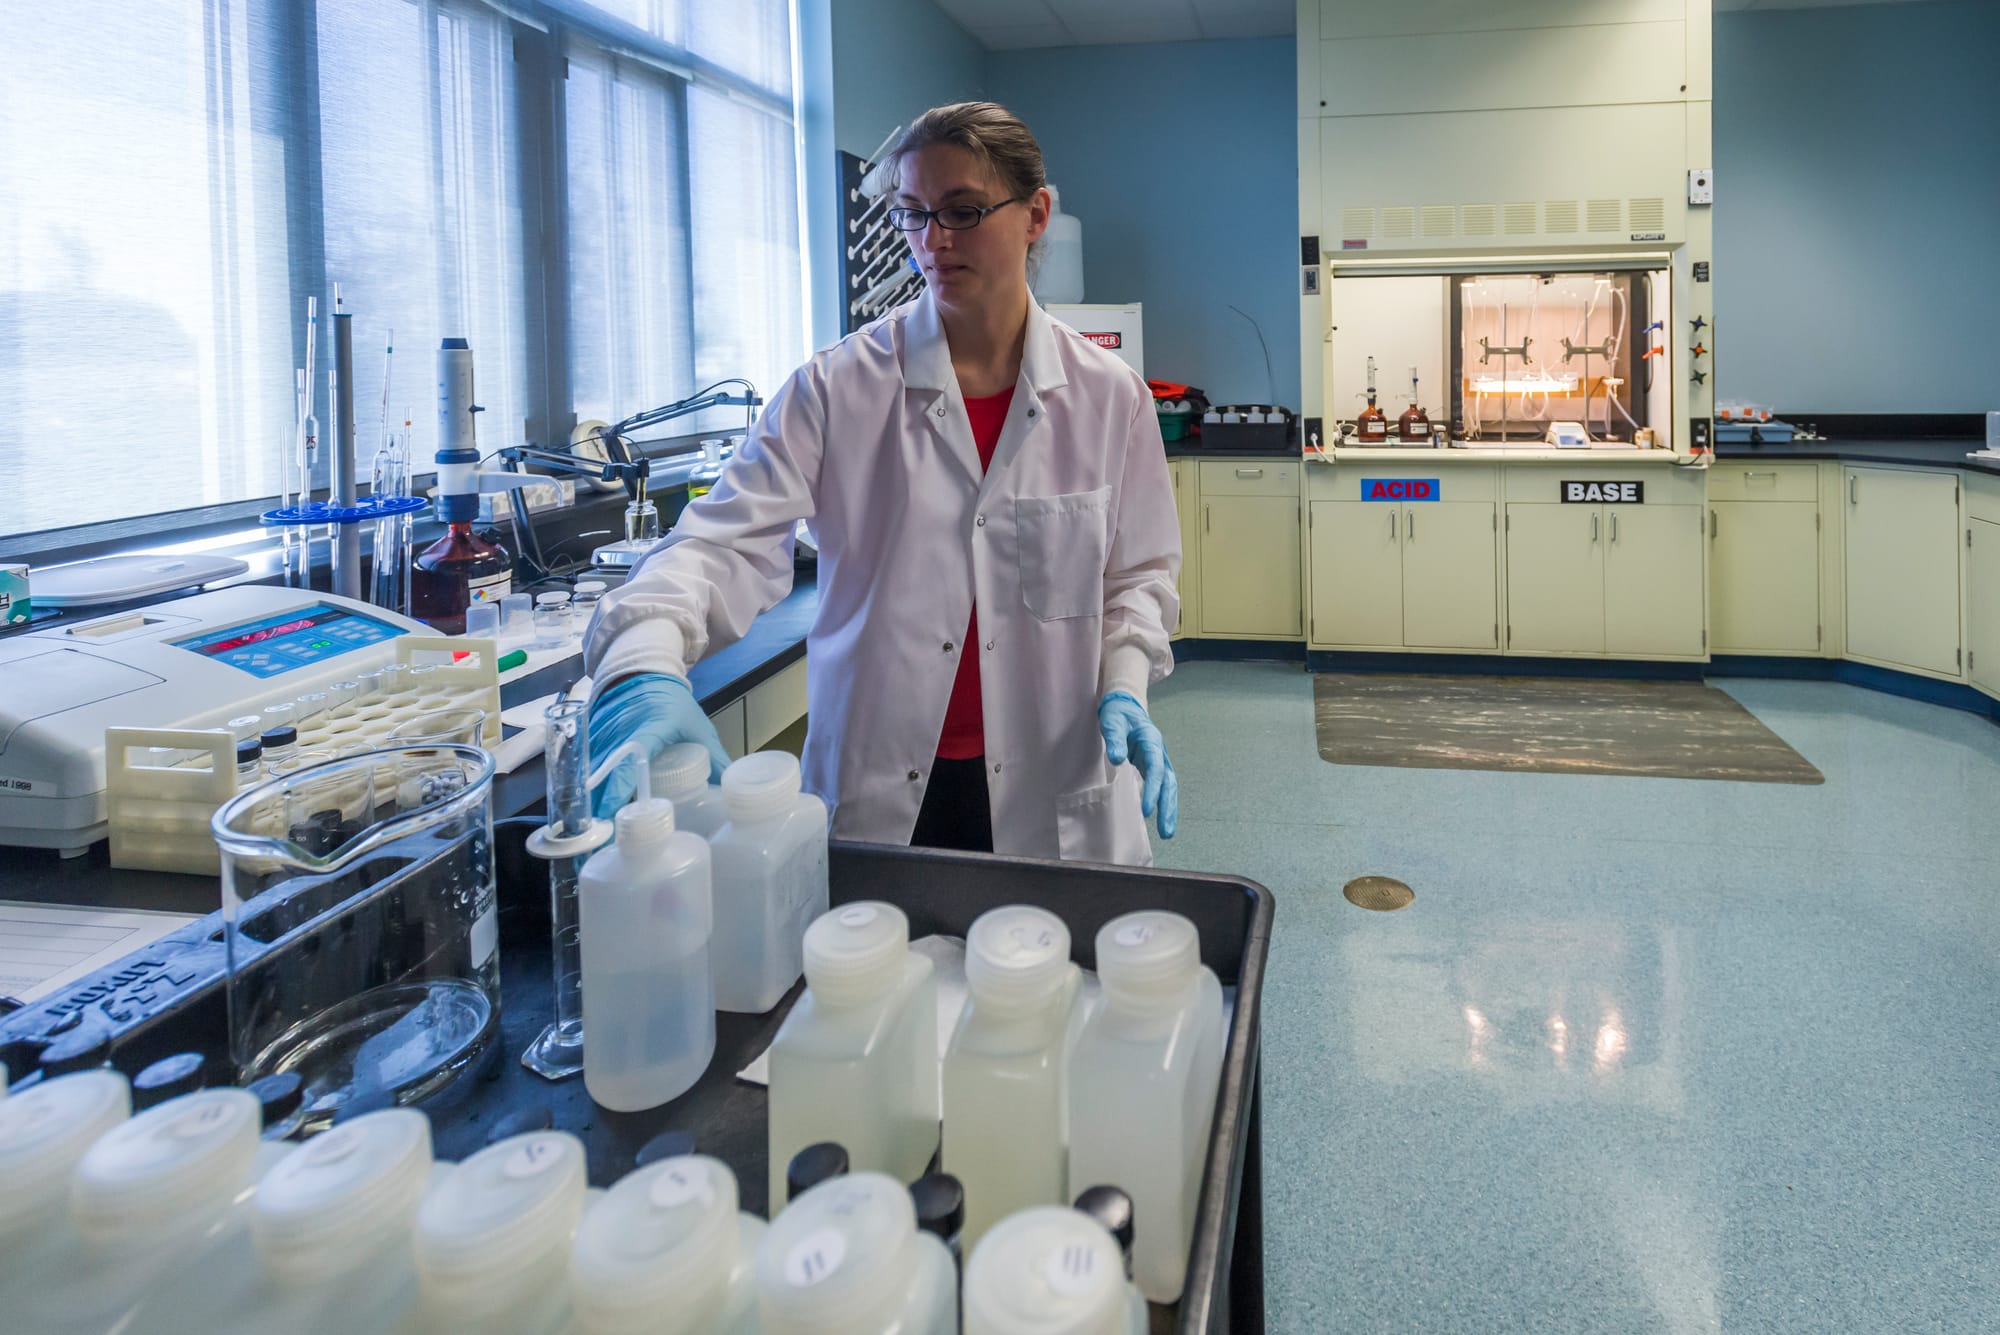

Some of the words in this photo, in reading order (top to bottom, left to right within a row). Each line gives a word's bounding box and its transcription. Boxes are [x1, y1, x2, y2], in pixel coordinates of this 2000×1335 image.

[1086, 335, 1117, 346] NGER
[305, 435, 317, 450] 25
[1371, 482, 1431, 498] ACID
[1567, 483, 1637, 501] BASE
